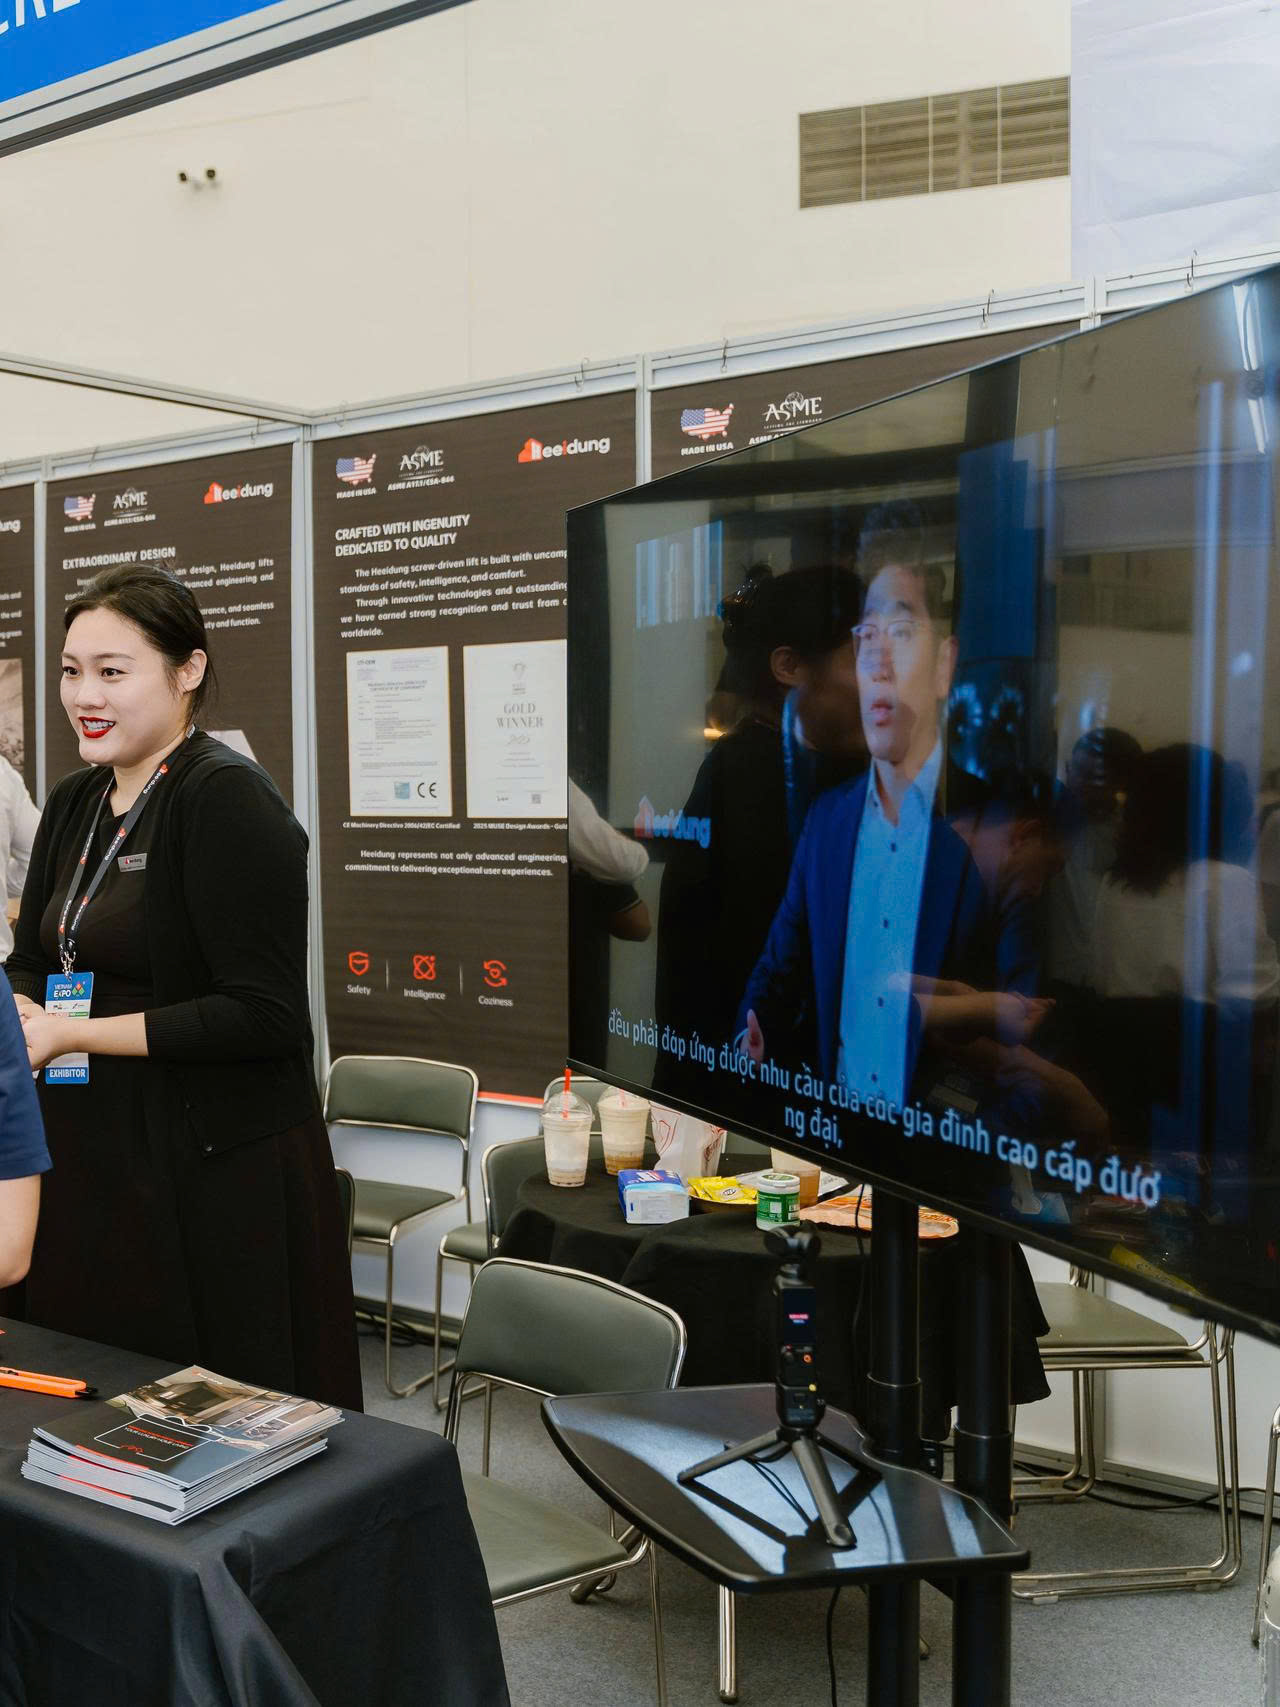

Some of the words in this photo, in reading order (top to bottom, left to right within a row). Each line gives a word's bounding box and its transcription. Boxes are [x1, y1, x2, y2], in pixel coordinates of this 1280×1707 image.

[762, 397, 822, 421] ASME
[681, 446, 705, 456] MADE
[706, 444, 715, 453] IN
[716, 441, 734, 451] USA
[399, 450, 444, 471] ASME
[113, 491, 148, 509] ASME
[335, 524, 380, 541] CRAFTED
[383, 520, 411, 535] WITH
[413, 514, 470, 532] INGENUITY
[335, 540, 392, 557] DEDICATED
[394, 538, 409, 551] TO
[411, 532, 457, 550] QUALITY
[63, 551, 138, 570] EXTRAORDINARY
[140, 547, 176, 560] DESIGN
[258, 558, 274, 567] lifts
[355, 568, 370, 578] The
[371, 565, 409, 575] Heeidung
[411, 557, 465, 572] screw-driven
[466, 556, 479, 567] lift
[480, 556, 489, 565] is
[490, 553, 510, 564] built
[512, 551, 532, 562] with
[215, 575, 257, 587] engineering
[260, 572, 274, 582] and
[340, 582, 379, 594] standards
[380, 580, 389, 591] of
[390, 579, 418, 590] safety,
[471, 572, 489, 582] and
[489, 569, 527, 580] comfort.
[356, 596, 388, 608] Through
[391, 593, 435, 605] innovative
[437, 588, 492, 601] technologies
[495, 585, 513, 596] and
[228, 604, 241, 613] and
[243, 602, 274, 612] seamless
[340, 615, 352, 623] we
[356, 613, 375, 622] have
[378, 610, 406, 620] earned
[409, 608, 437, 619] strong
[439, 603, 488, 616] recognition
[491, 601, 509, 612] and
[512, 600, 534, 610] trust
[537, 598, 559, 608] from
[216, 619, 230, 628] and
[341, 626, 384, 638] worldwide.
[504, 703, 536, 714] GOLD
[496, 716, 543, 728] WINNER
[360, 849, 396, 861] Heeidung
[398, 851, 438, 861] represents
[440, 852, 453, 860] not
[456, 852, 473, 862] only
[475, 852, 516, 861] advanced
[345, 863, 391, 872] commitment
[391, 864, 400, 873] to
[400, 864, 437, 875] delivering
[438, 865, 483, 876] exceptional
[483, 867, 501, 875] user
[501, 867, 554, 877] experiences.
[53, 990, 71, 998] EXPO
[347, 985, 371, 996] Safety
[404, 988, 446, 1000] Intelligence
[478, 995, 513, 1007] Coziness
[49, 1068, 86, 1078] EXHIBITOR
[608, 1007, 630, 1039] đều
[633, 1018, 659, 1048] phải
[662, 1025, 686, 1061] đáp
[689, 1031, 715, 1072] ứng
[719, 1042, 756, 1084] được
[760, 1058, 790, 1091] nhu
[794, 1062, 823, 1102] cầu
[829, 1073, 860, 1113] của
[903, 1102, 933, 1138] gia
[940, 1107, 990, 1155] đình
[996, 1135, 1038, 1170] cao
[1045, 1140, 1093, 1193] cấp
[784, 1104, 805, 1139] ng
[809, 1109, 843, 1150] đại,
